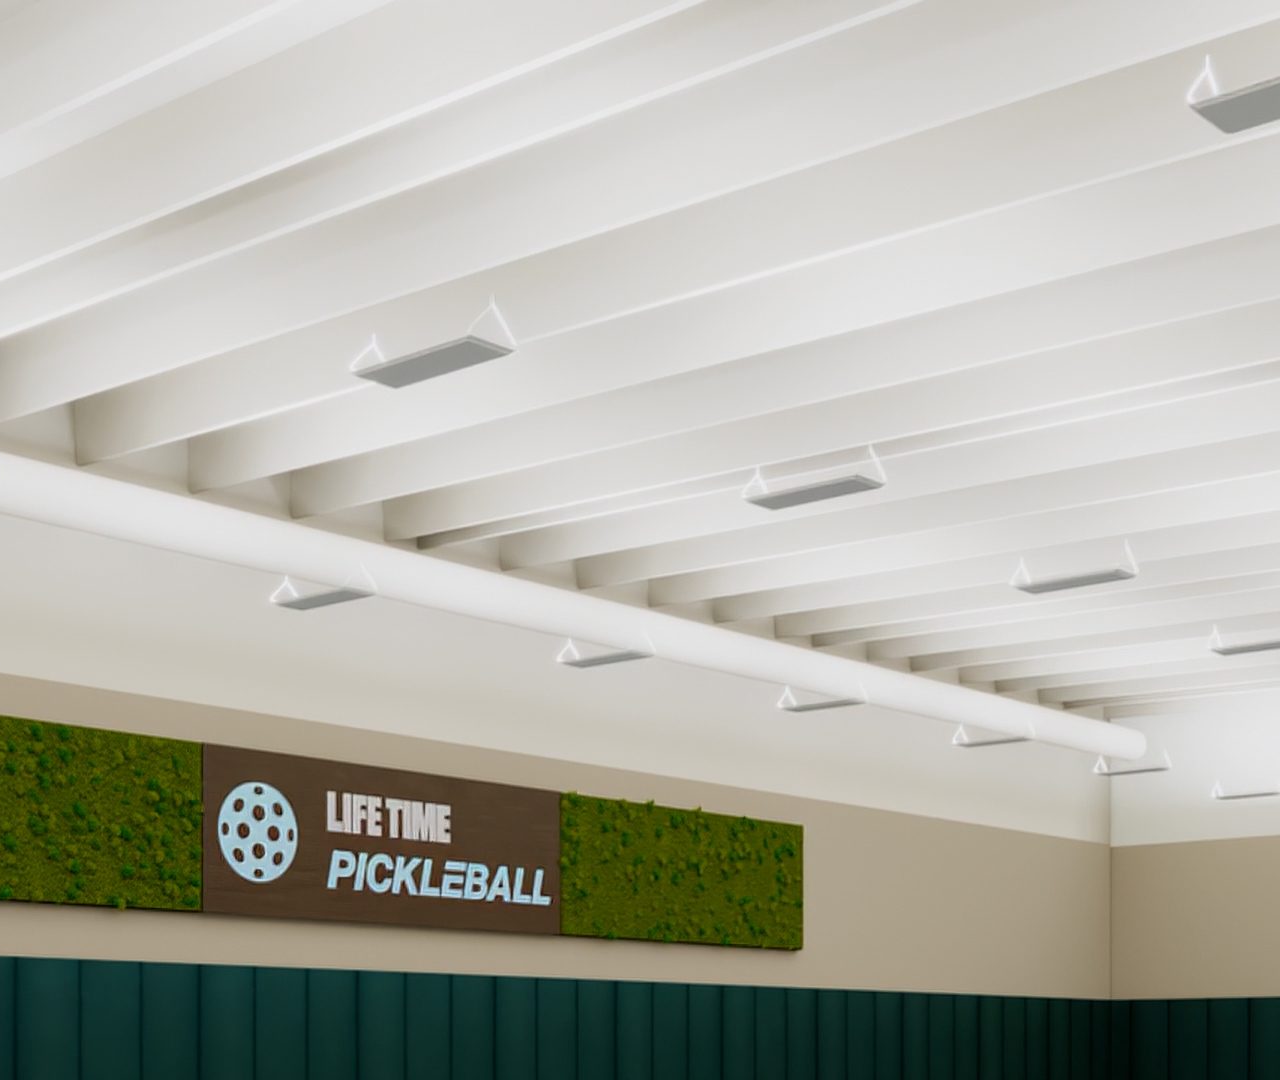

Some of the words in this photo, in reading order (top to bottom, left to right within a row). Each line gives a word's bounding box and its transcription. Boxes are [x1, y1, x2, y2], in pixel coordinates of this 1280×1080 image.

[327, 791, 383, 837] LIFE
[385, 798, 452, 844] TIME
[327, 849, 552, 906] PICKLEBALL
